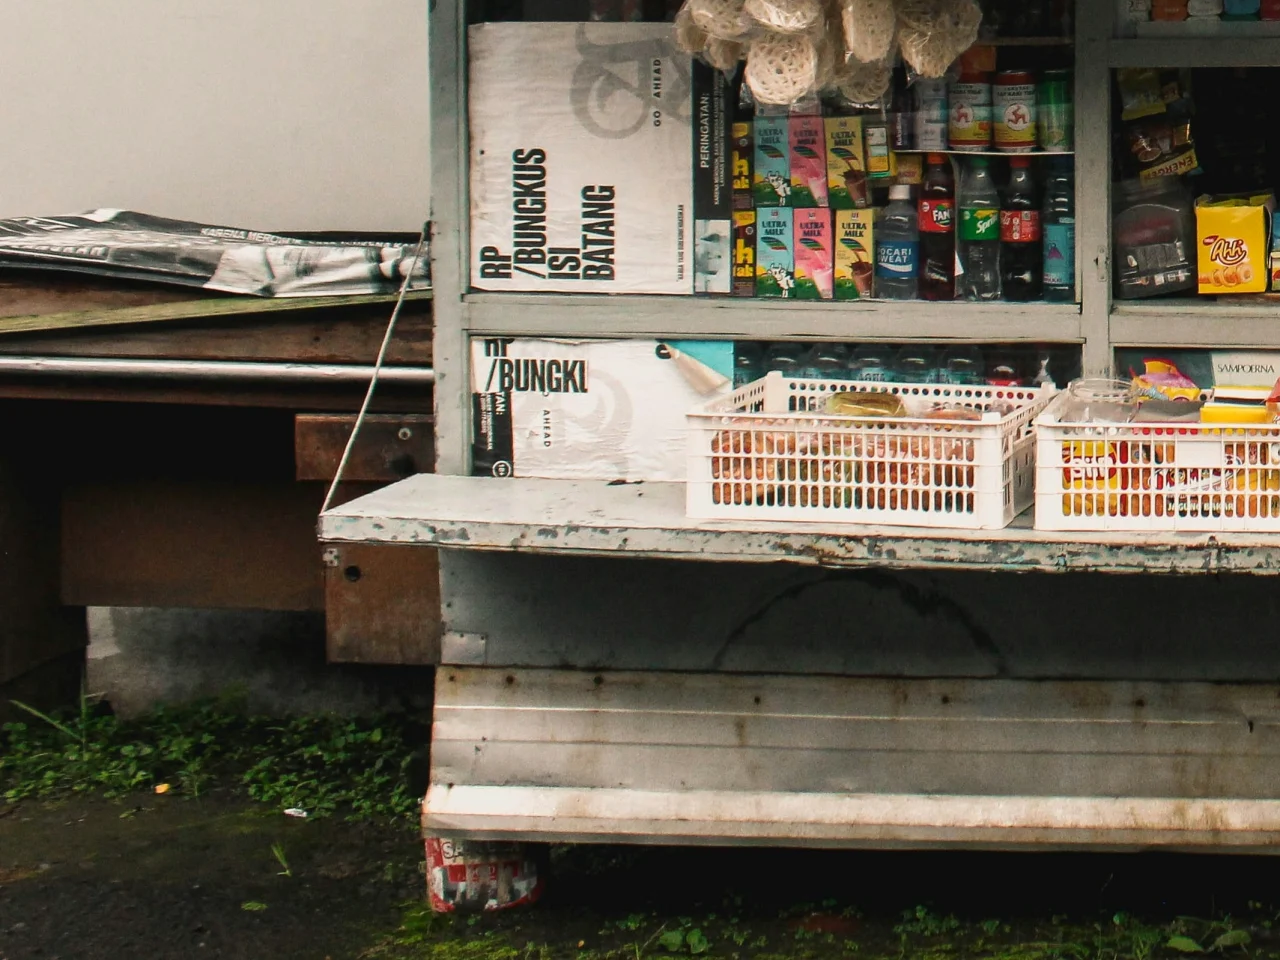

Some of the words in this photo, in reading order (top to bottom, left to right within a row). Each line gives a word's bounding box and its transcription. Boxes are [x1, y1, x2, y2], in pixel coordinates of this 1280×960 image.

[653, 58, 662, 99] AHEAD
[653, 110, 662, 128] GO
[701, 92, 711, 168] PERINGATAN:
[834, 138, 853, 146] MILK
[513, 148, 546, 279] /BUNGKUS
[932, 210, 950, 222] FAN
[201, 227, 245, 240] KARENA
[581, 185, 615, 280] BATANG
[764, 228, 784, 236] MILK
[844, 230, 864, 238] MILK
[878, 247, 912, 256] OCARI
[480, 246, 512, 279] RP
[548, 247, 580, 279] ISI
[878, 256, 908, 264] WEAT
[1217, 364, 1275, 373] SAMPOERNA
[542, 410, 551, 447] AHEAD
